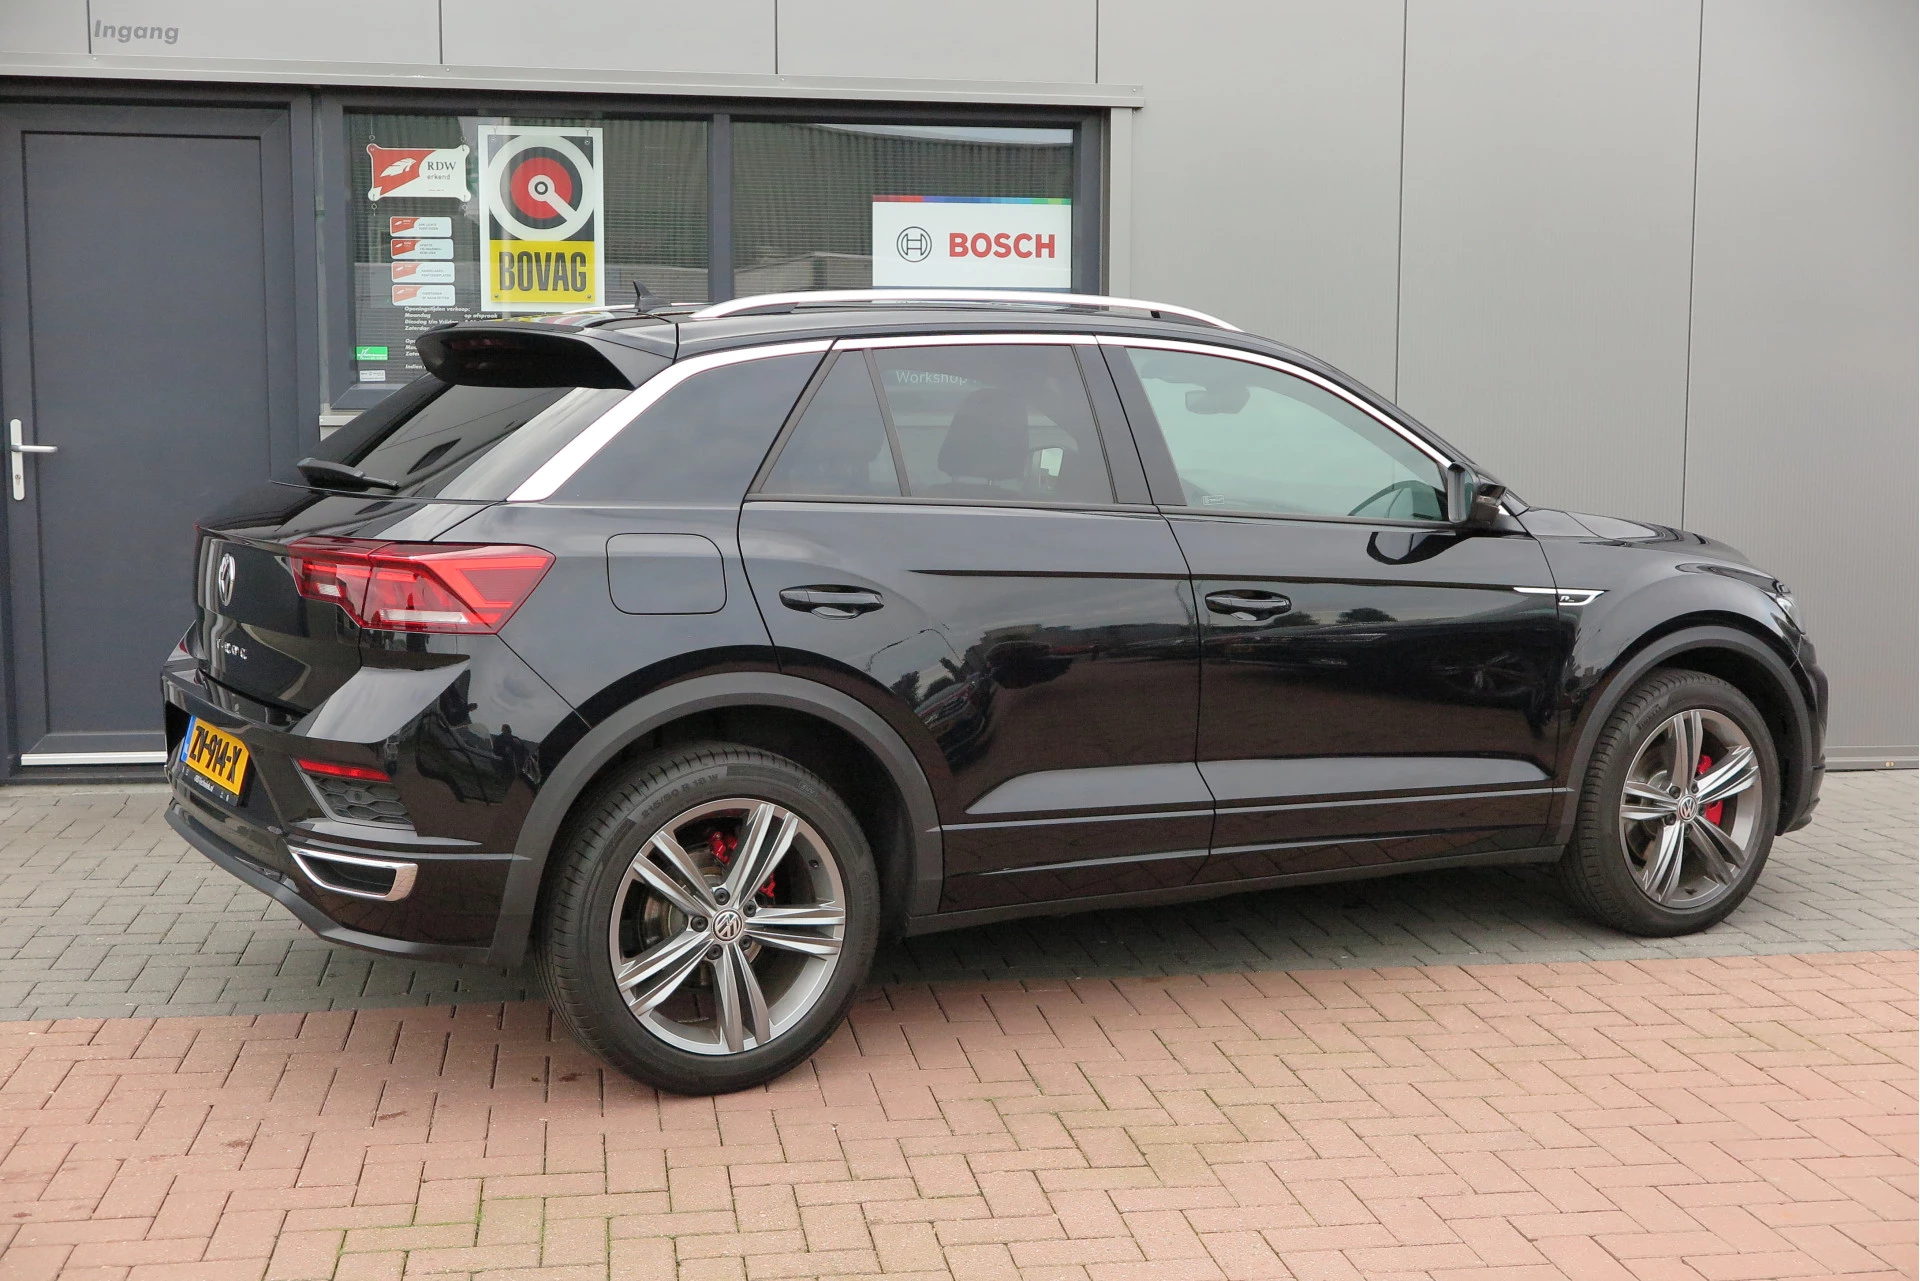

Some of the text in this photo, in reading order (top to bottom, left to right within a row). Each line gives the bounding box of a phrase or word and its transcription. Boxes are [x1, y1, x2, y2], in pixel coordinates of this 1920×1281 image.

[94, 20, 179, 44] Ingang
[427, 161, 456, 170] RDW
[949, 232, 1055, 259] BOSCH
[499, 251, 586, 292] BOVAG
